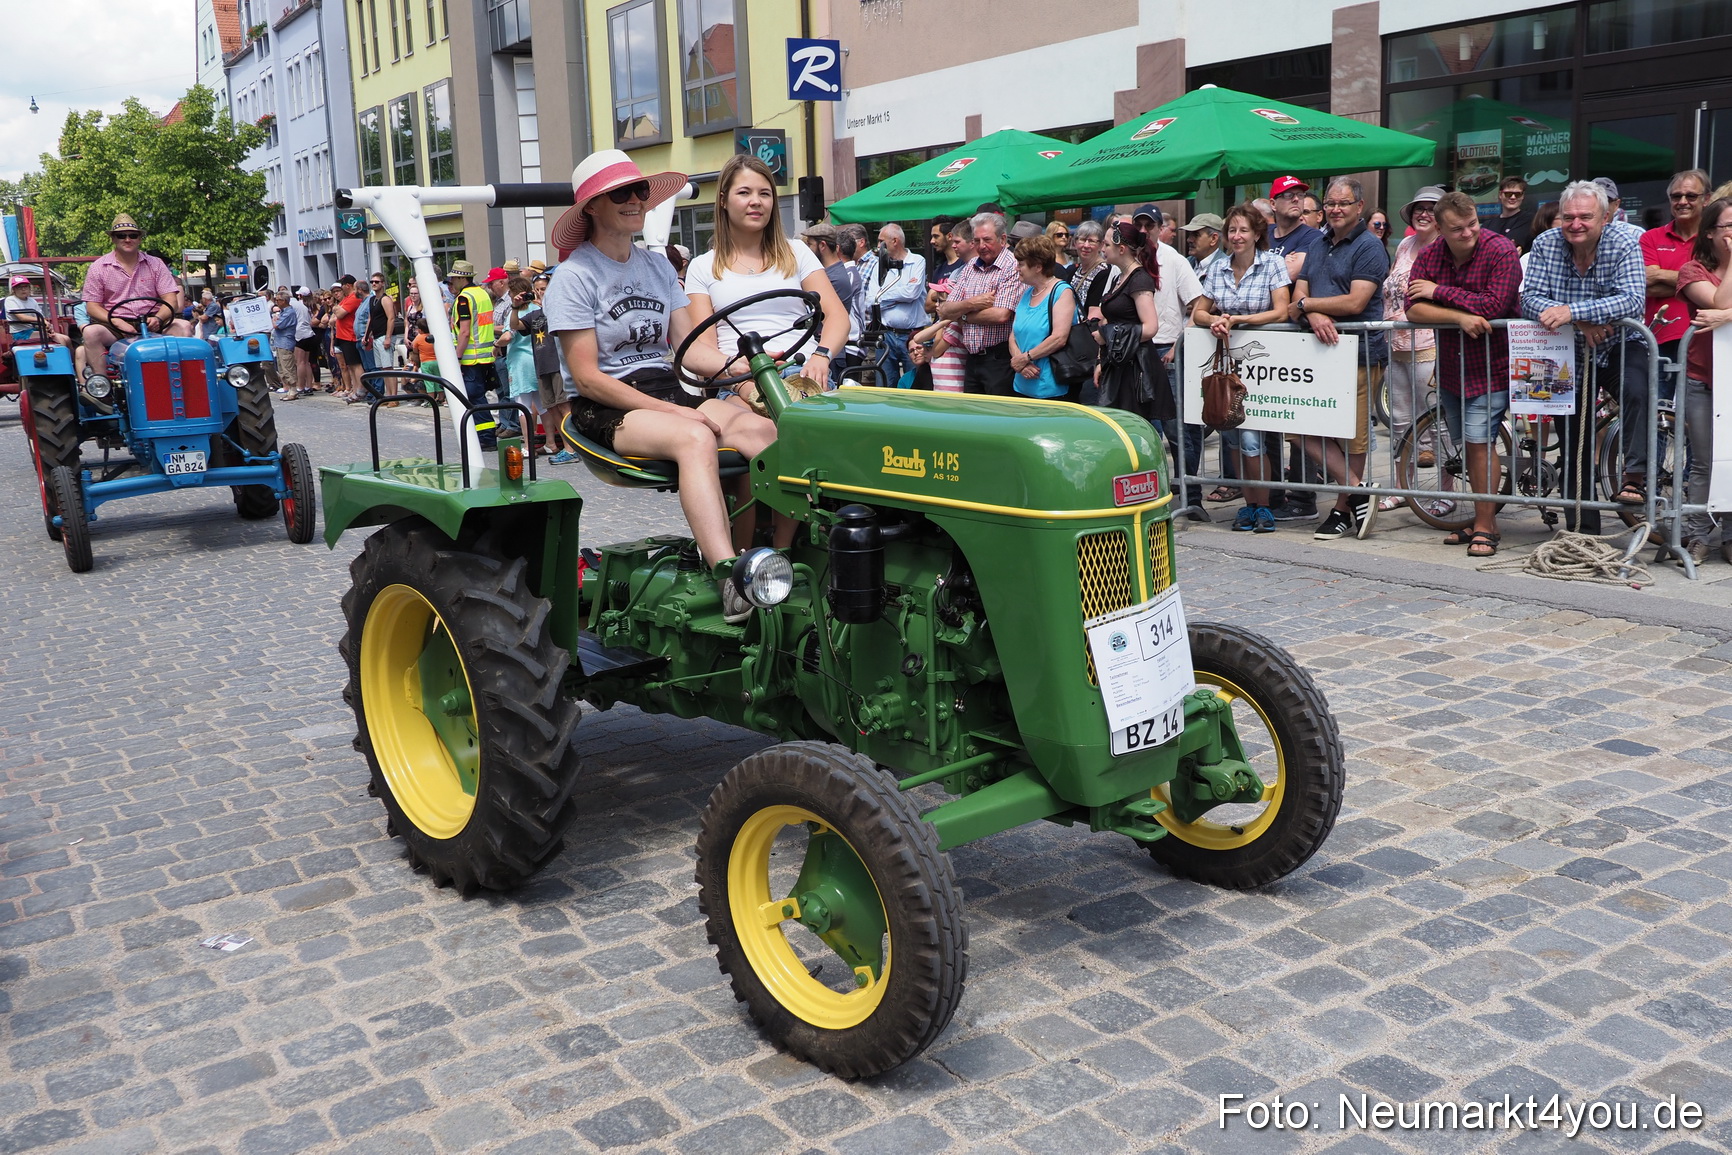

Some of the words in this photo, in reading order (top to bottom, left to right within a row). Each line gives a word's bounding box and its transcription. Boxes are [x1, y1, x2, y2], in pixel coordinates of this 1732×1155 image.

[791, 46, 839, 93] R.
[847, 118, 866, 129] Unterer
[867, 113, 882, 125] Markt
[883, 110, 891, 122] 15
[1269, 132, 1367, 141] Lammsbräu
[1526, 131, 1570, 146] MÄNNER
[1095, 139, 1166, 155] Neumarkter
[1460, 144, 1499, 158] OLDTIMER
[1526, 143, 1570, 156] SACHE(N)
[756, 144, 774, 167] G2
[1068, 145, 1166, 167] Lammsbräu
[908, 178, 962, 188] Neumarkter
[885, 185, 960, 197] Lammsbräu
[347, 216, 358, 229] G2
[246, 304, 261, 313] 338
[612, 303, 627, 316] THE
[627, 299, 661, 311] LEGEND
[1235, 360, 1314, 385] Express
[1244, 408, 1295, 420] eumarkt
[171, 454, 186, 463] NM
[882, 445, 926, 478] Bautz
[932, 451, 944, 469] 14
[946, 452, 959, 471] PS
[168, 464, 182, 473] GA
[185, 462, 203, 472] 824
[946, 474, 959, 482] 120
[1120, 473, 1155, 502] Bautz
[1150, 614, 1173, 646] 314
[1126, 718, 1157, 750] BZ
[1162, 708, 1179, 740] 14
